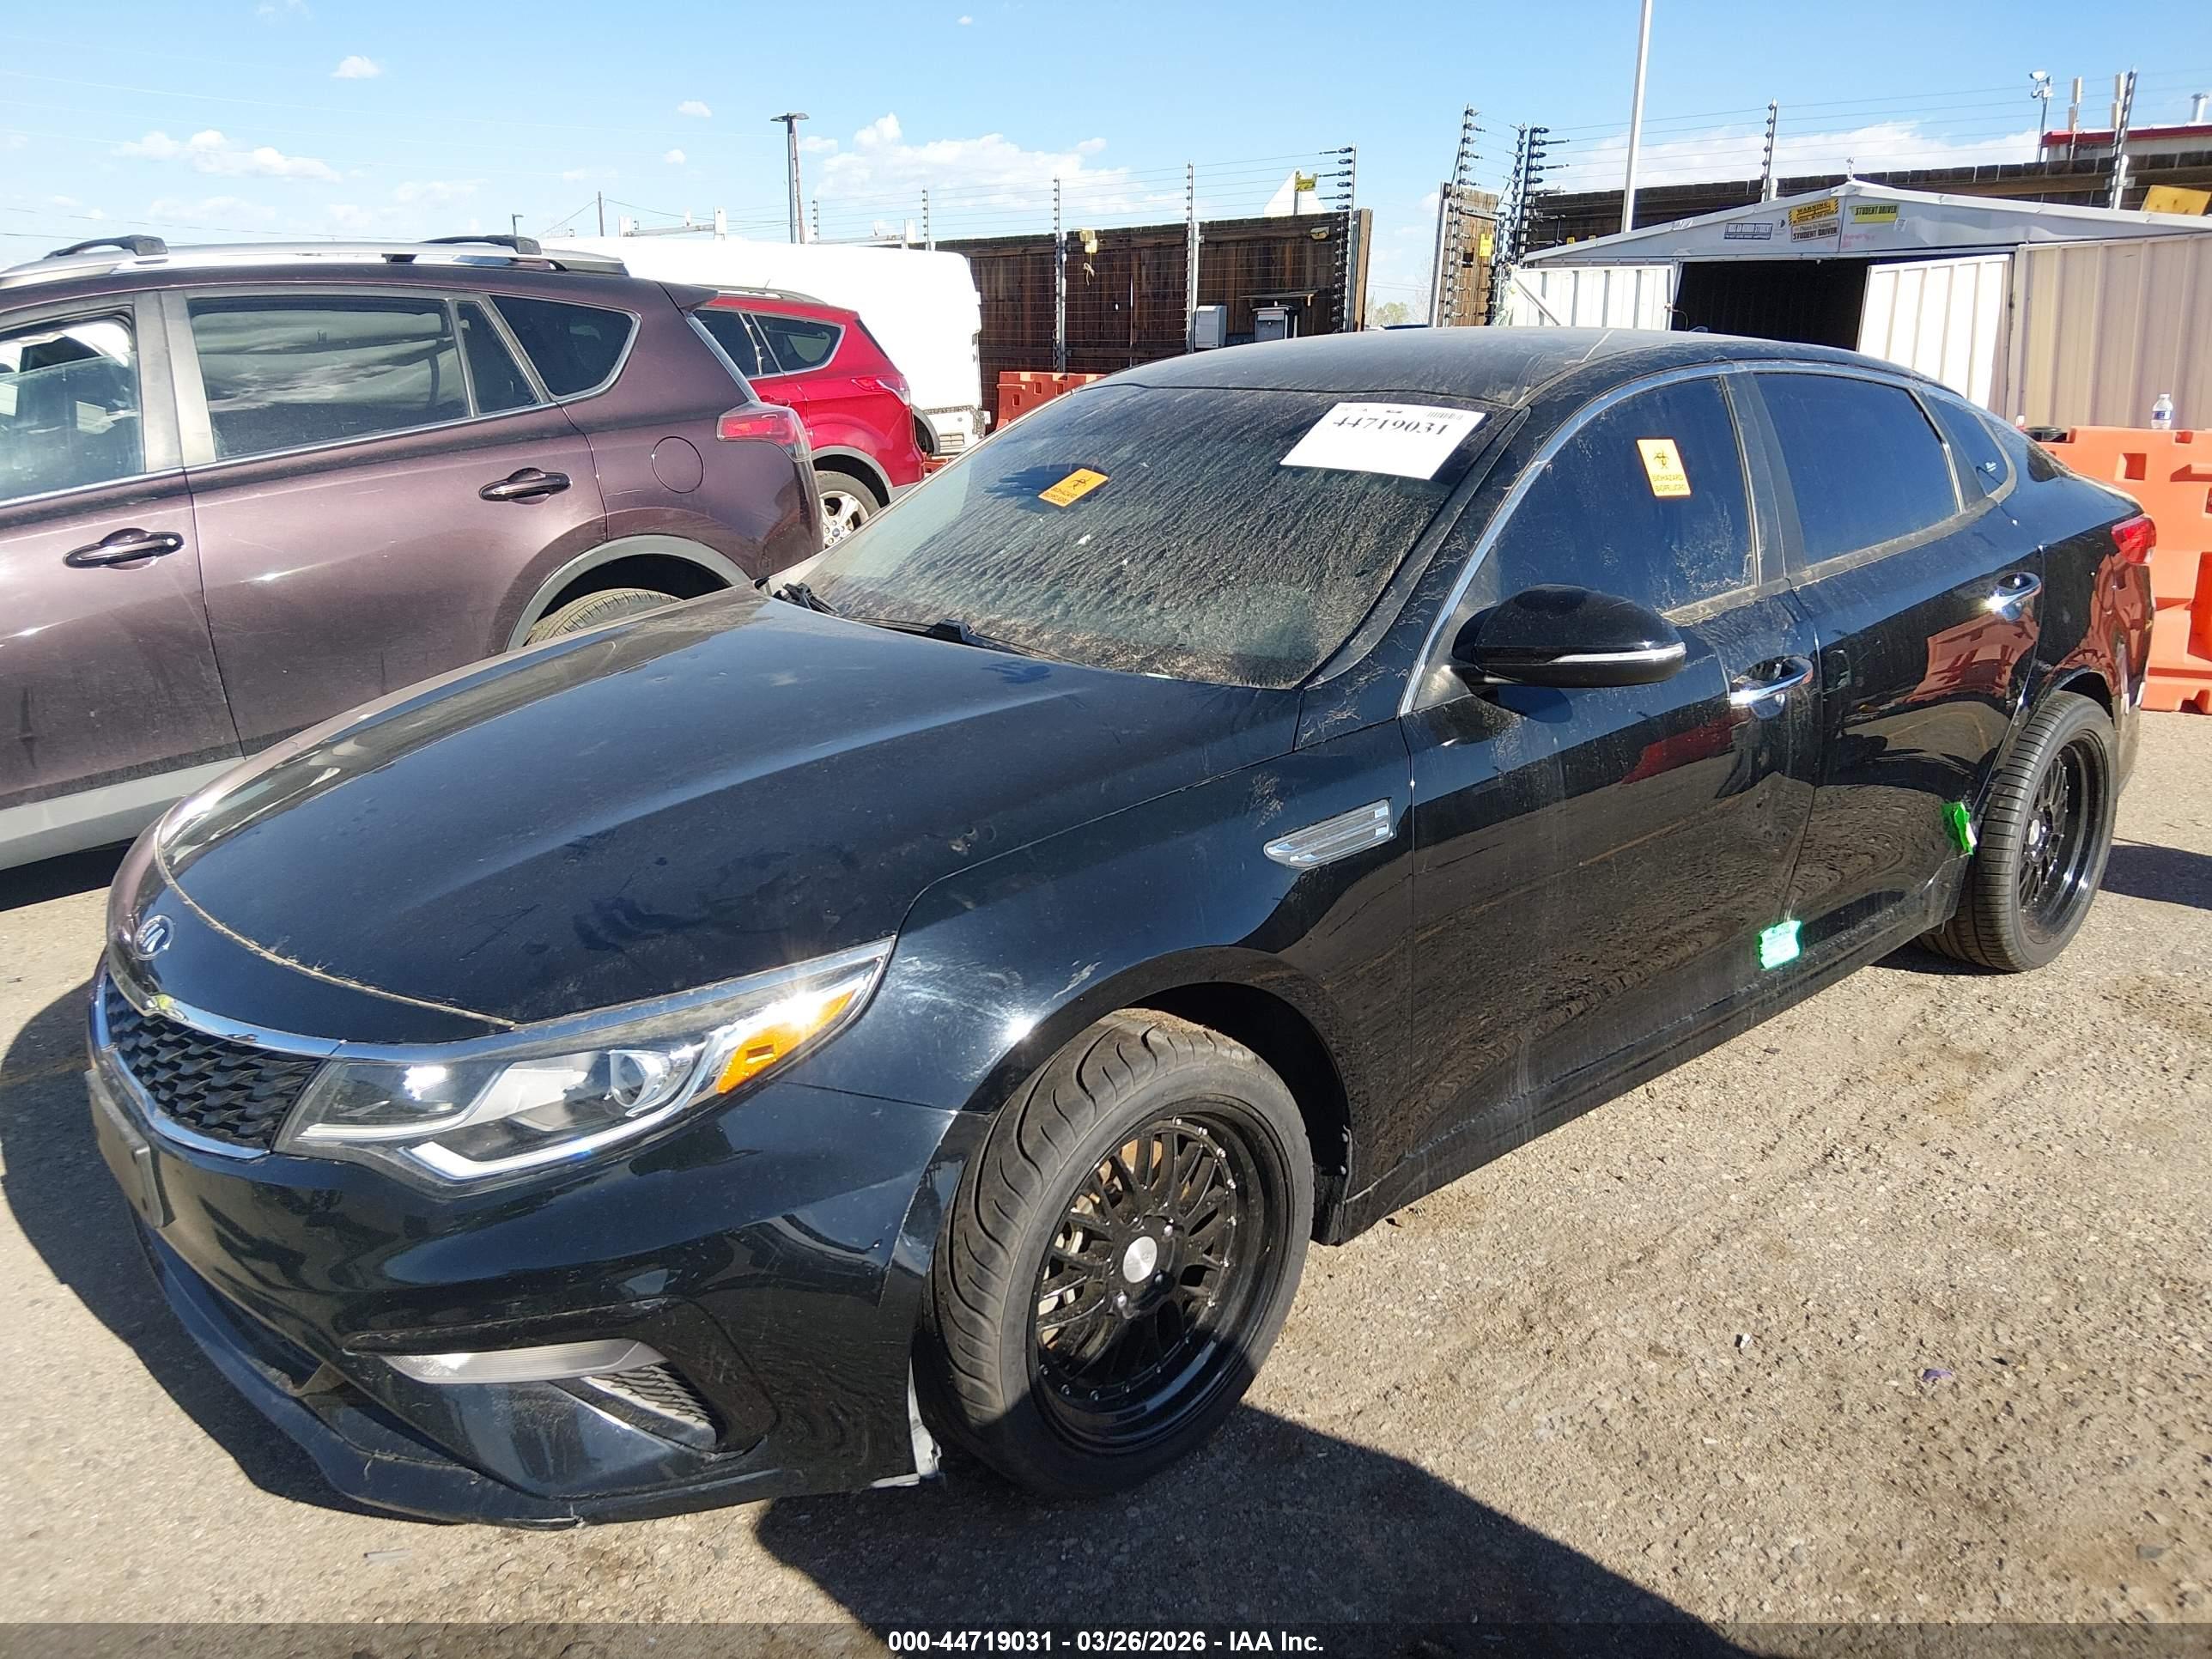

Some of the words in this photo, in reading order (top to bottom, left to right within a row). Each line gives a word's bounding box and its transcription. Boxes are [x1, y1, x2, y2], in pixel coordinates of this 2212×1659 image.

[1796, 202, 1828, 214] WARNING
[1855, 206, 1878, 216] STUDENT
[1878, 205, 1898, 214] DRIVER
[1793, 230, 1817, 240] STUDENT
[1818, 227, 1838, 236] DRIVER
[1333, 416, 1449, 435] 44719031
